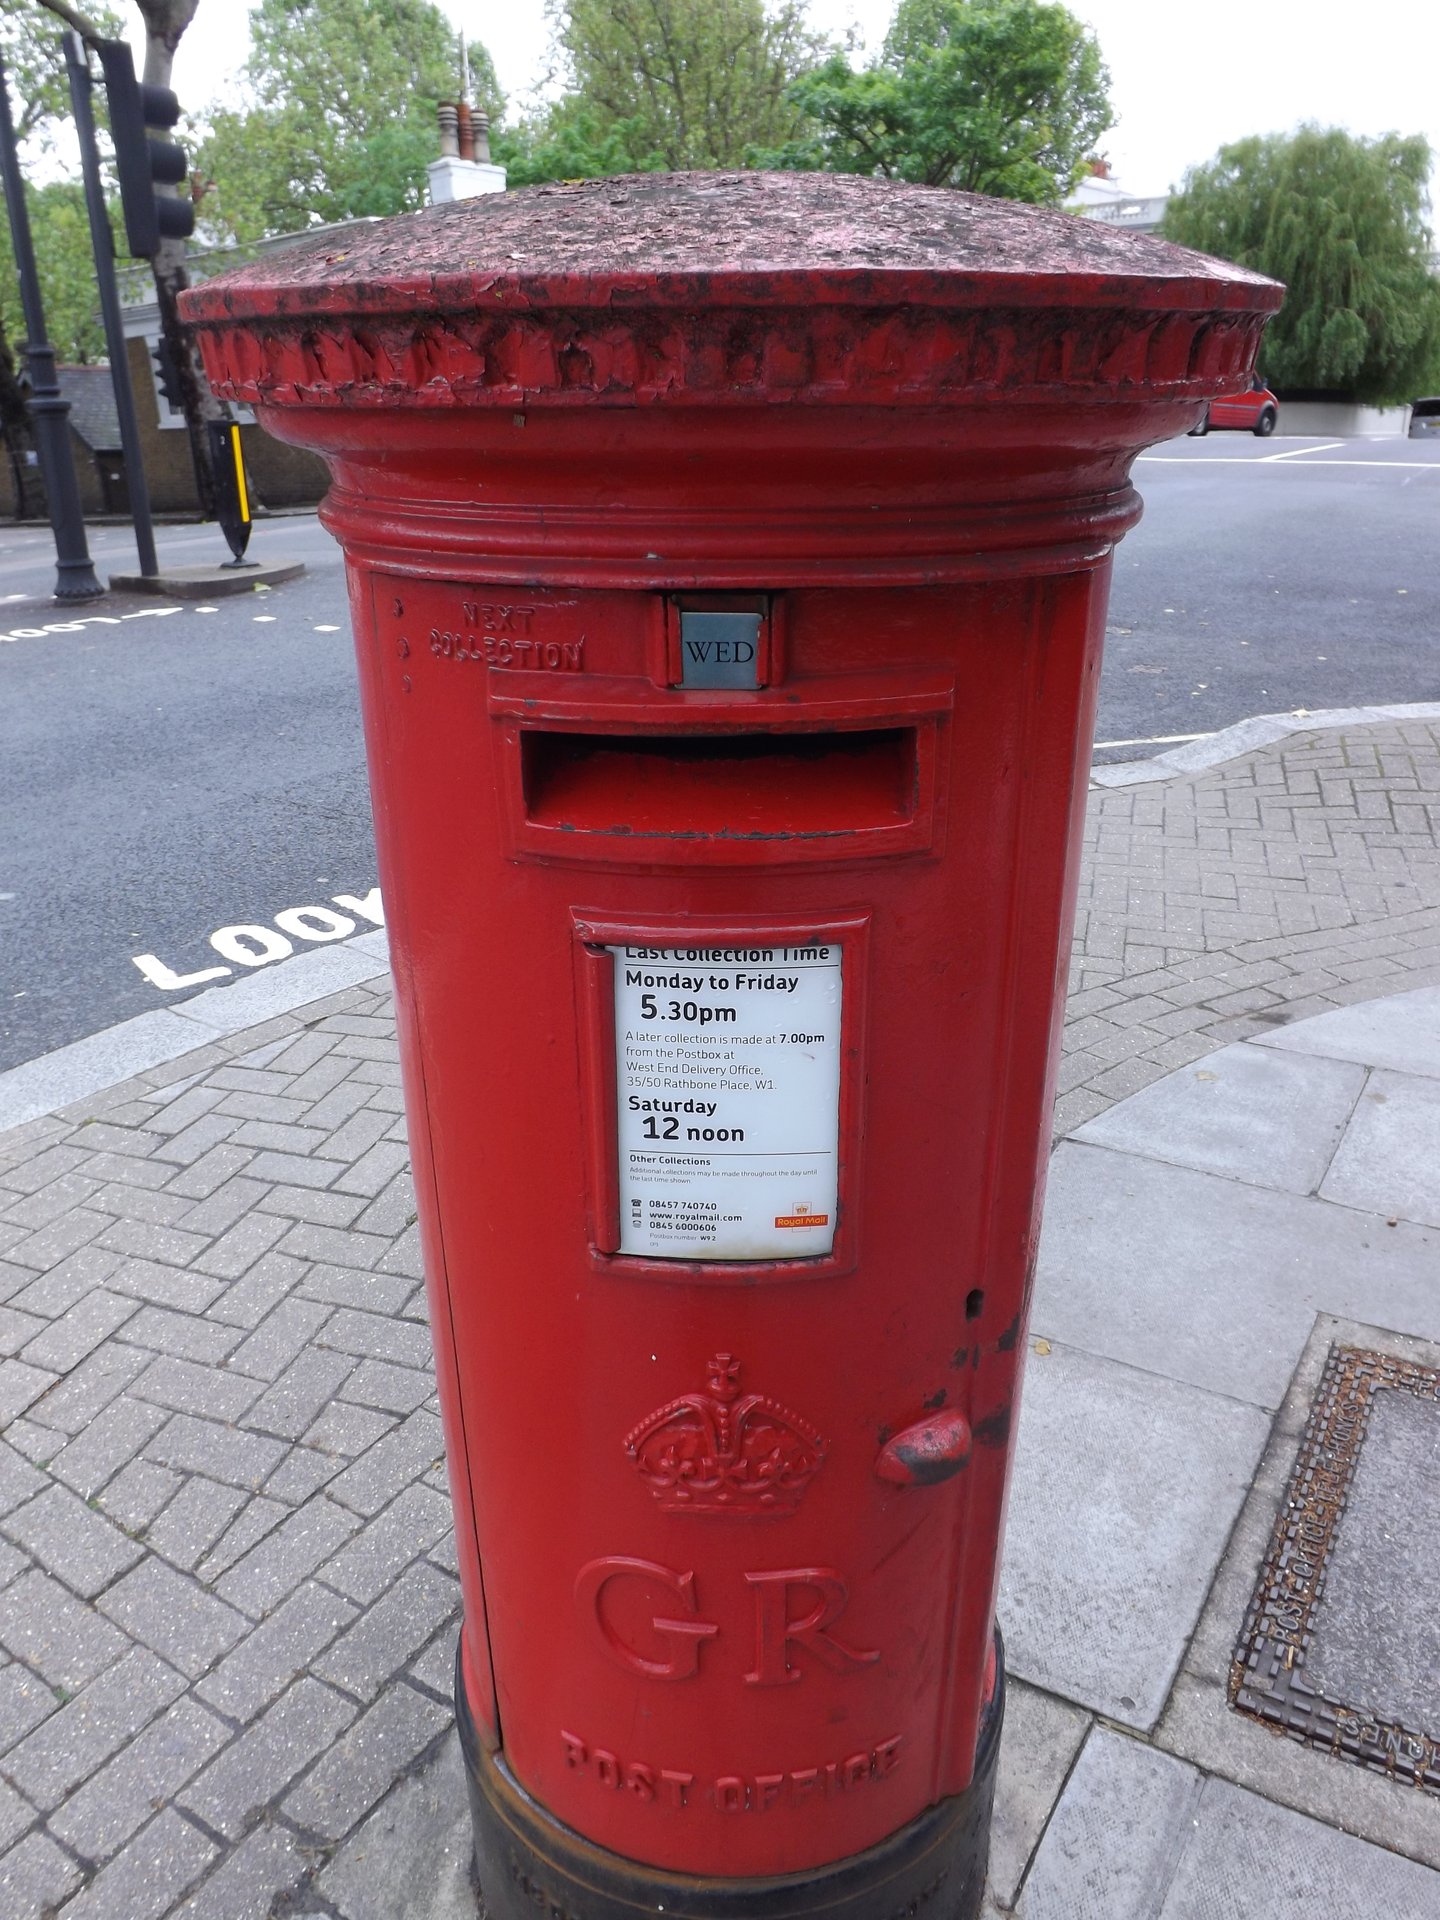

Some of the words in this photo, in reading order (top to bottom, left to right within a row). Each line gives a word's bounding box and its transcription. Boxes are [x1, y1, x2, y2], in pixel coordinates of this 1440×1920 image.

[462, 601, 537, 633] NEXT
[430, 627, 586, 671] COLLECTION
[686, 640, 755, 664] WED
[625, 946, 669, 960] Last
[673, 948, 774, 962] Collection
[626, 969, 703, 993] Monday
[709, 975, 729, 990] to
[735, 974, 799, 993] Friday
[641, 994, 737, 1026] 5.30pm
[625, 1030, 634, 1041] A
[636, 1031, 661, 1043] later
[664, 1032, 717, 1045] collection
[719, 1034, 729, 1045] is
[731, 1034, 763, 1045] made
[765, 1035, 777, 1045] at
[779, 1033, 825, 1046] 7.00pm
[626, 1047, 653, 1058] from
[655, 1048, 674, 1059] the
[676, 1049, 721, 1060] Postbox
[723, 1051, 735, 1060] at
[626, 1061, 655, 1073] West
[657, 1063, 679, 1074] End
[682, 1064, 727, 1077] Delivery
[729, 1065, 764, 1076] Office,
[626, 1076, 661, 1088] 35/50
[664, 1078, 717, 1090] Rathbone
[720, 1079, 752, 1091] Place,
[755, 1080, 777, 1091] W1.
[628, 1095, 717, 1116] Saturday
[642, 1115, 680, 1140] 12
[686, 1127, 745, 1142] noon
[629, 1154, 657, 1164] Other
[659, 1156, 711, 1166] Collections
[712, 1169, 721, 1177] be
[740, 1169, 777, 1178] throughout
[790, 1169, 801, 1177] day
[802, 1168, 818, 1176] until
[649, 1199, 679, 1209] 08457
[681, 1201, 717, 1211] 740740
[649, 1212, 742, 1222] www.royalmail.com
[778, 1217, 804, 1227] Royal
[805, 1216, 826, 1225] Mail
[649, 1221, 673, 1230] 0845
[675, 1222, 717, 1232] 6000606
[561, 1729, 693, 1807] POST
[715, 1733, 902, 1811] OFFICE
